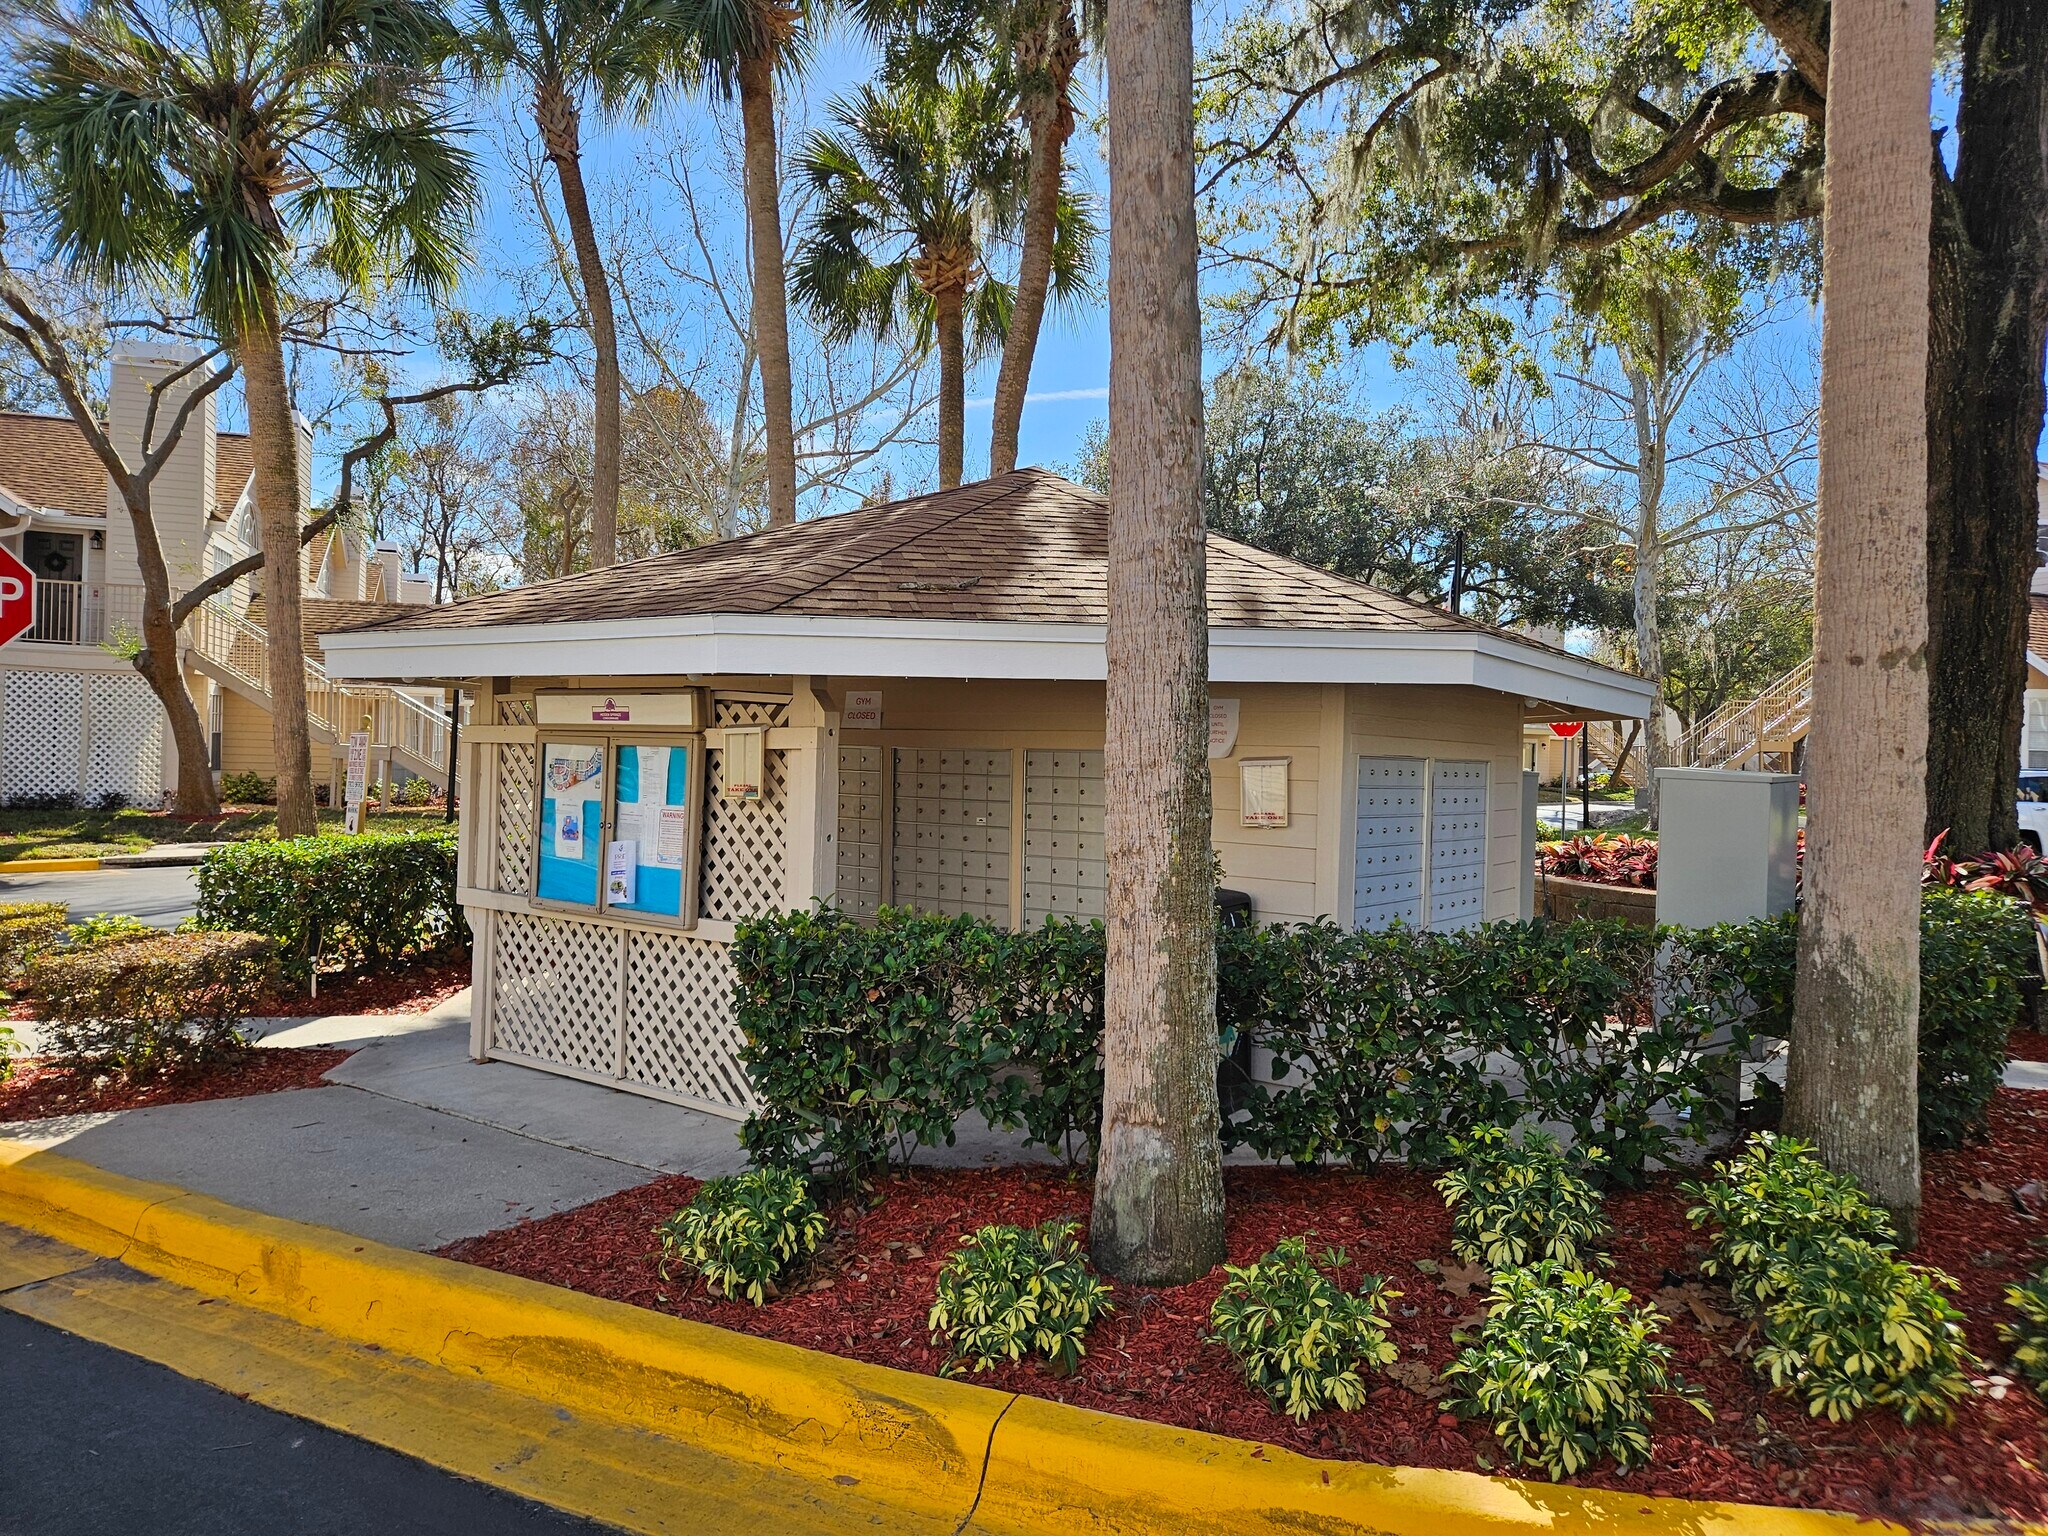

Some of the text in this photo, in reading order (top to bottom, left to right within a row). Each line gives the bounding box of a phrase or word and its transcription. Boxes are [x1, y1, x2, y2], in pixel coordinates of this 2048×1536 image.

[856, 697, 872, 705] GYM
[848, 711, 876, 720] CLOSED
[662, 811, 684, 819] WARNING
